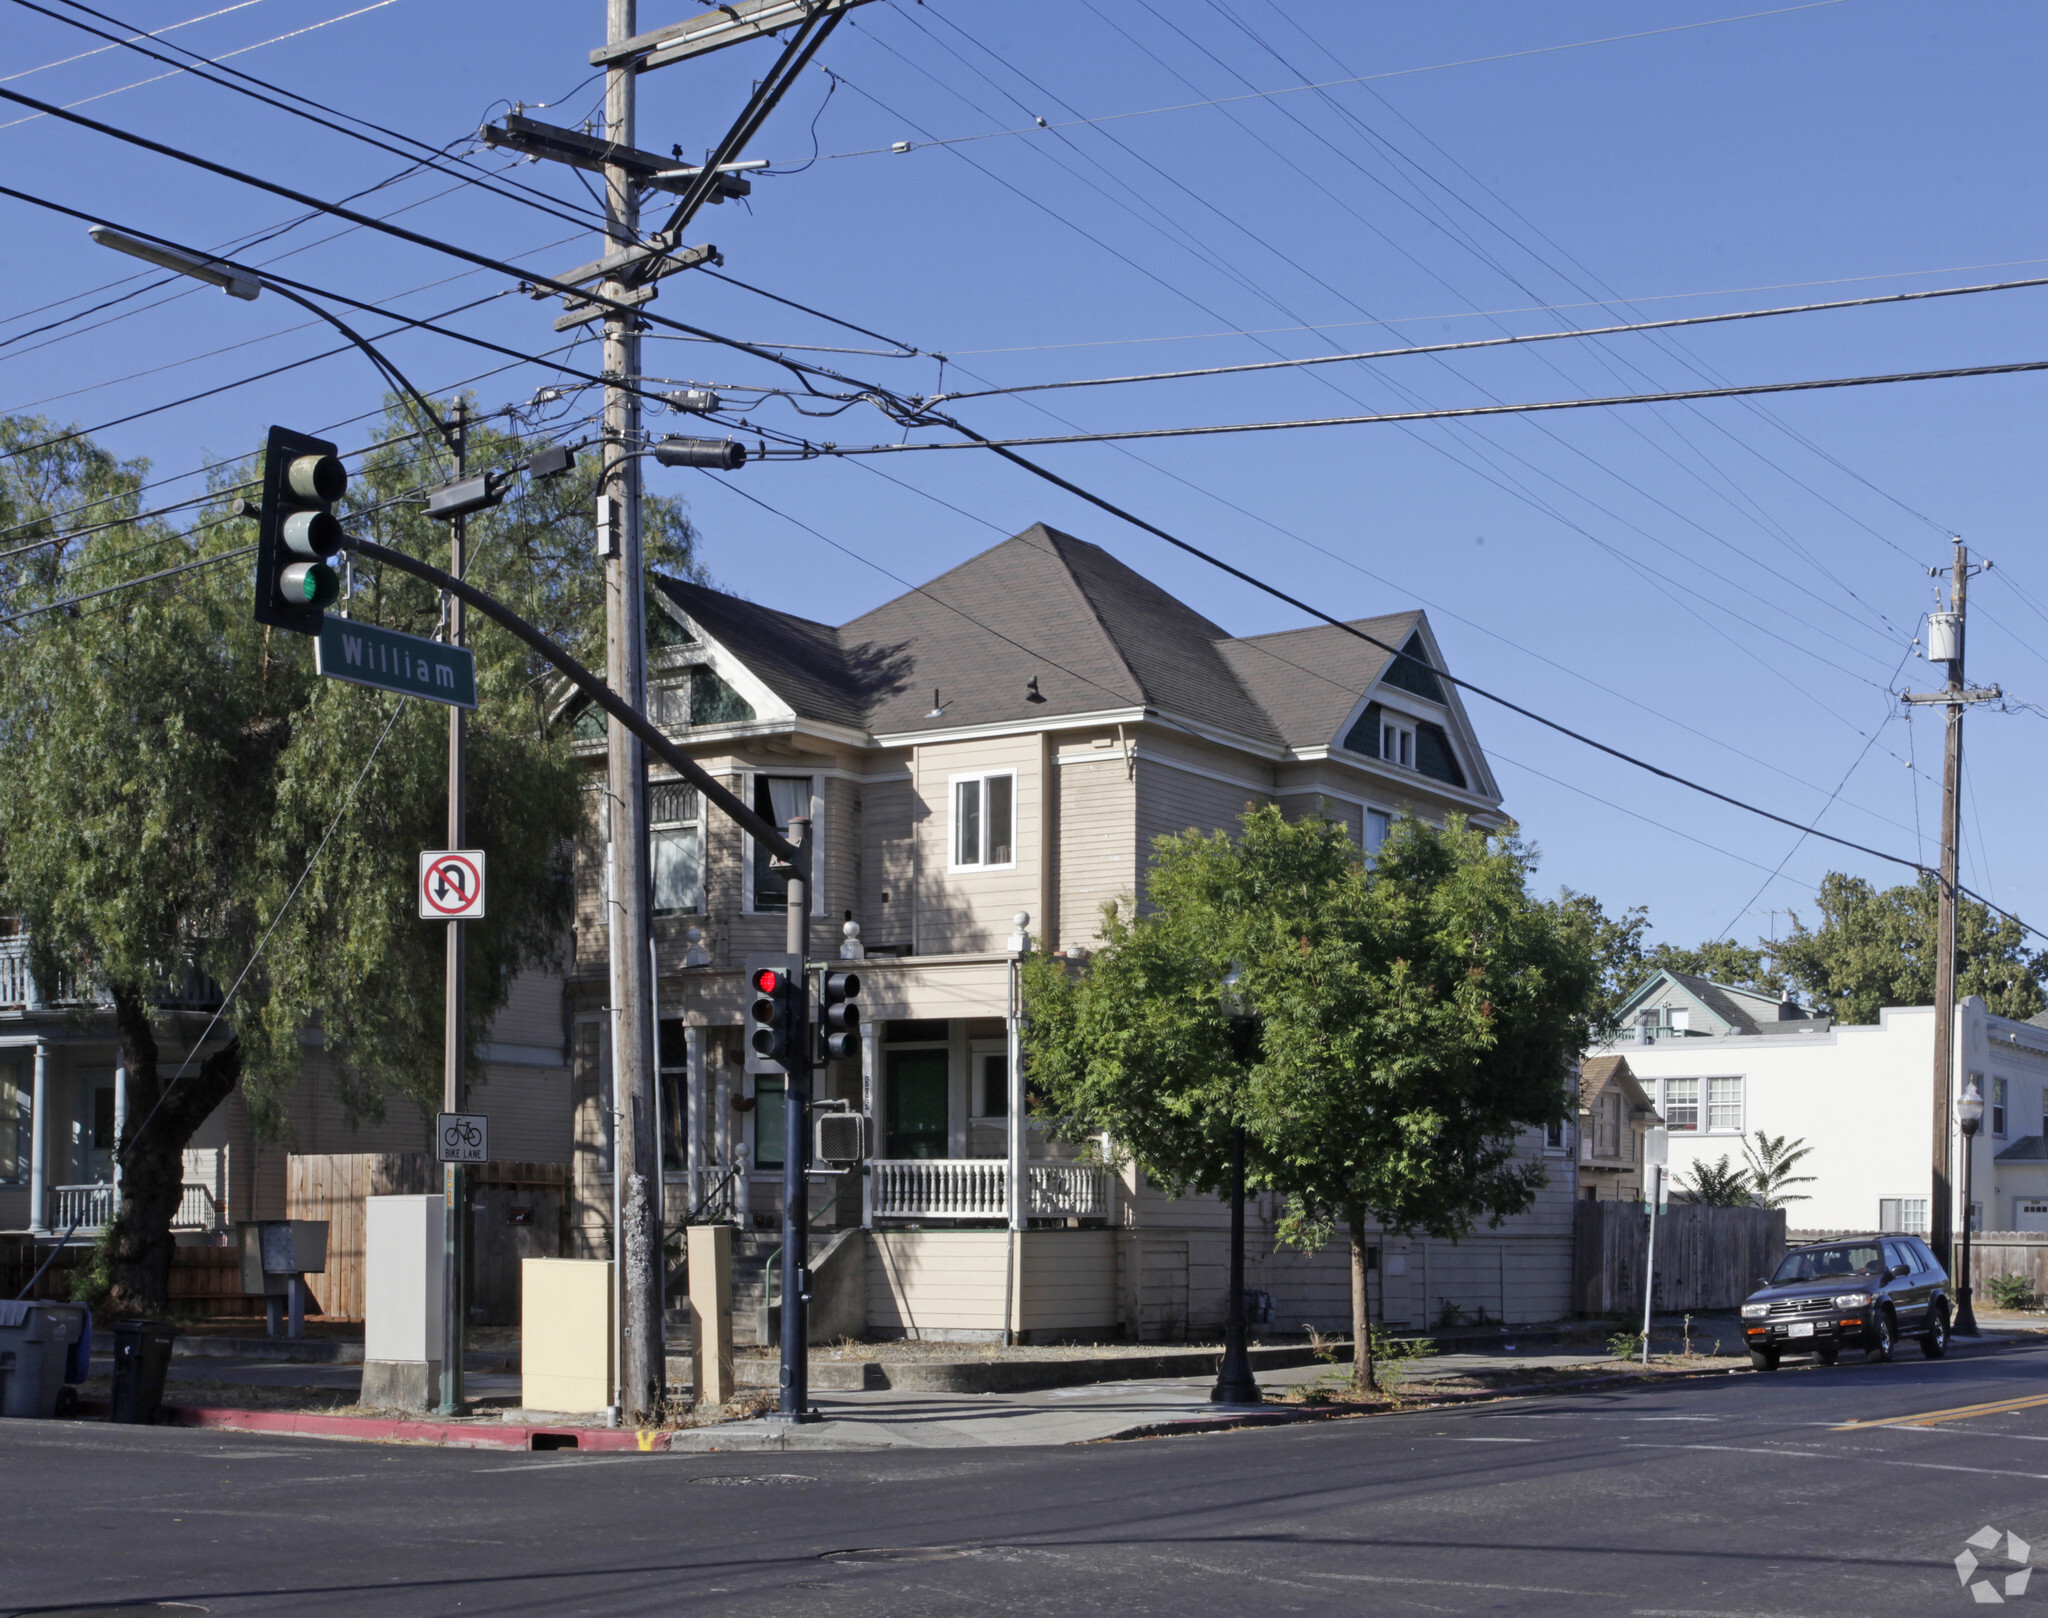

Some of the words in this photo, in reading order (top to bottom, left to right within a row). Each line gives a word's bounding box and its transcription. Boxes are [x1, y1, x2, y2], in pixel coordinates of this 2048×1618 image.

[342, 634, 455, 689] William
[445, 1149, 460, 1158] BIKE
[463, 1149, 482, 1159] LANE
